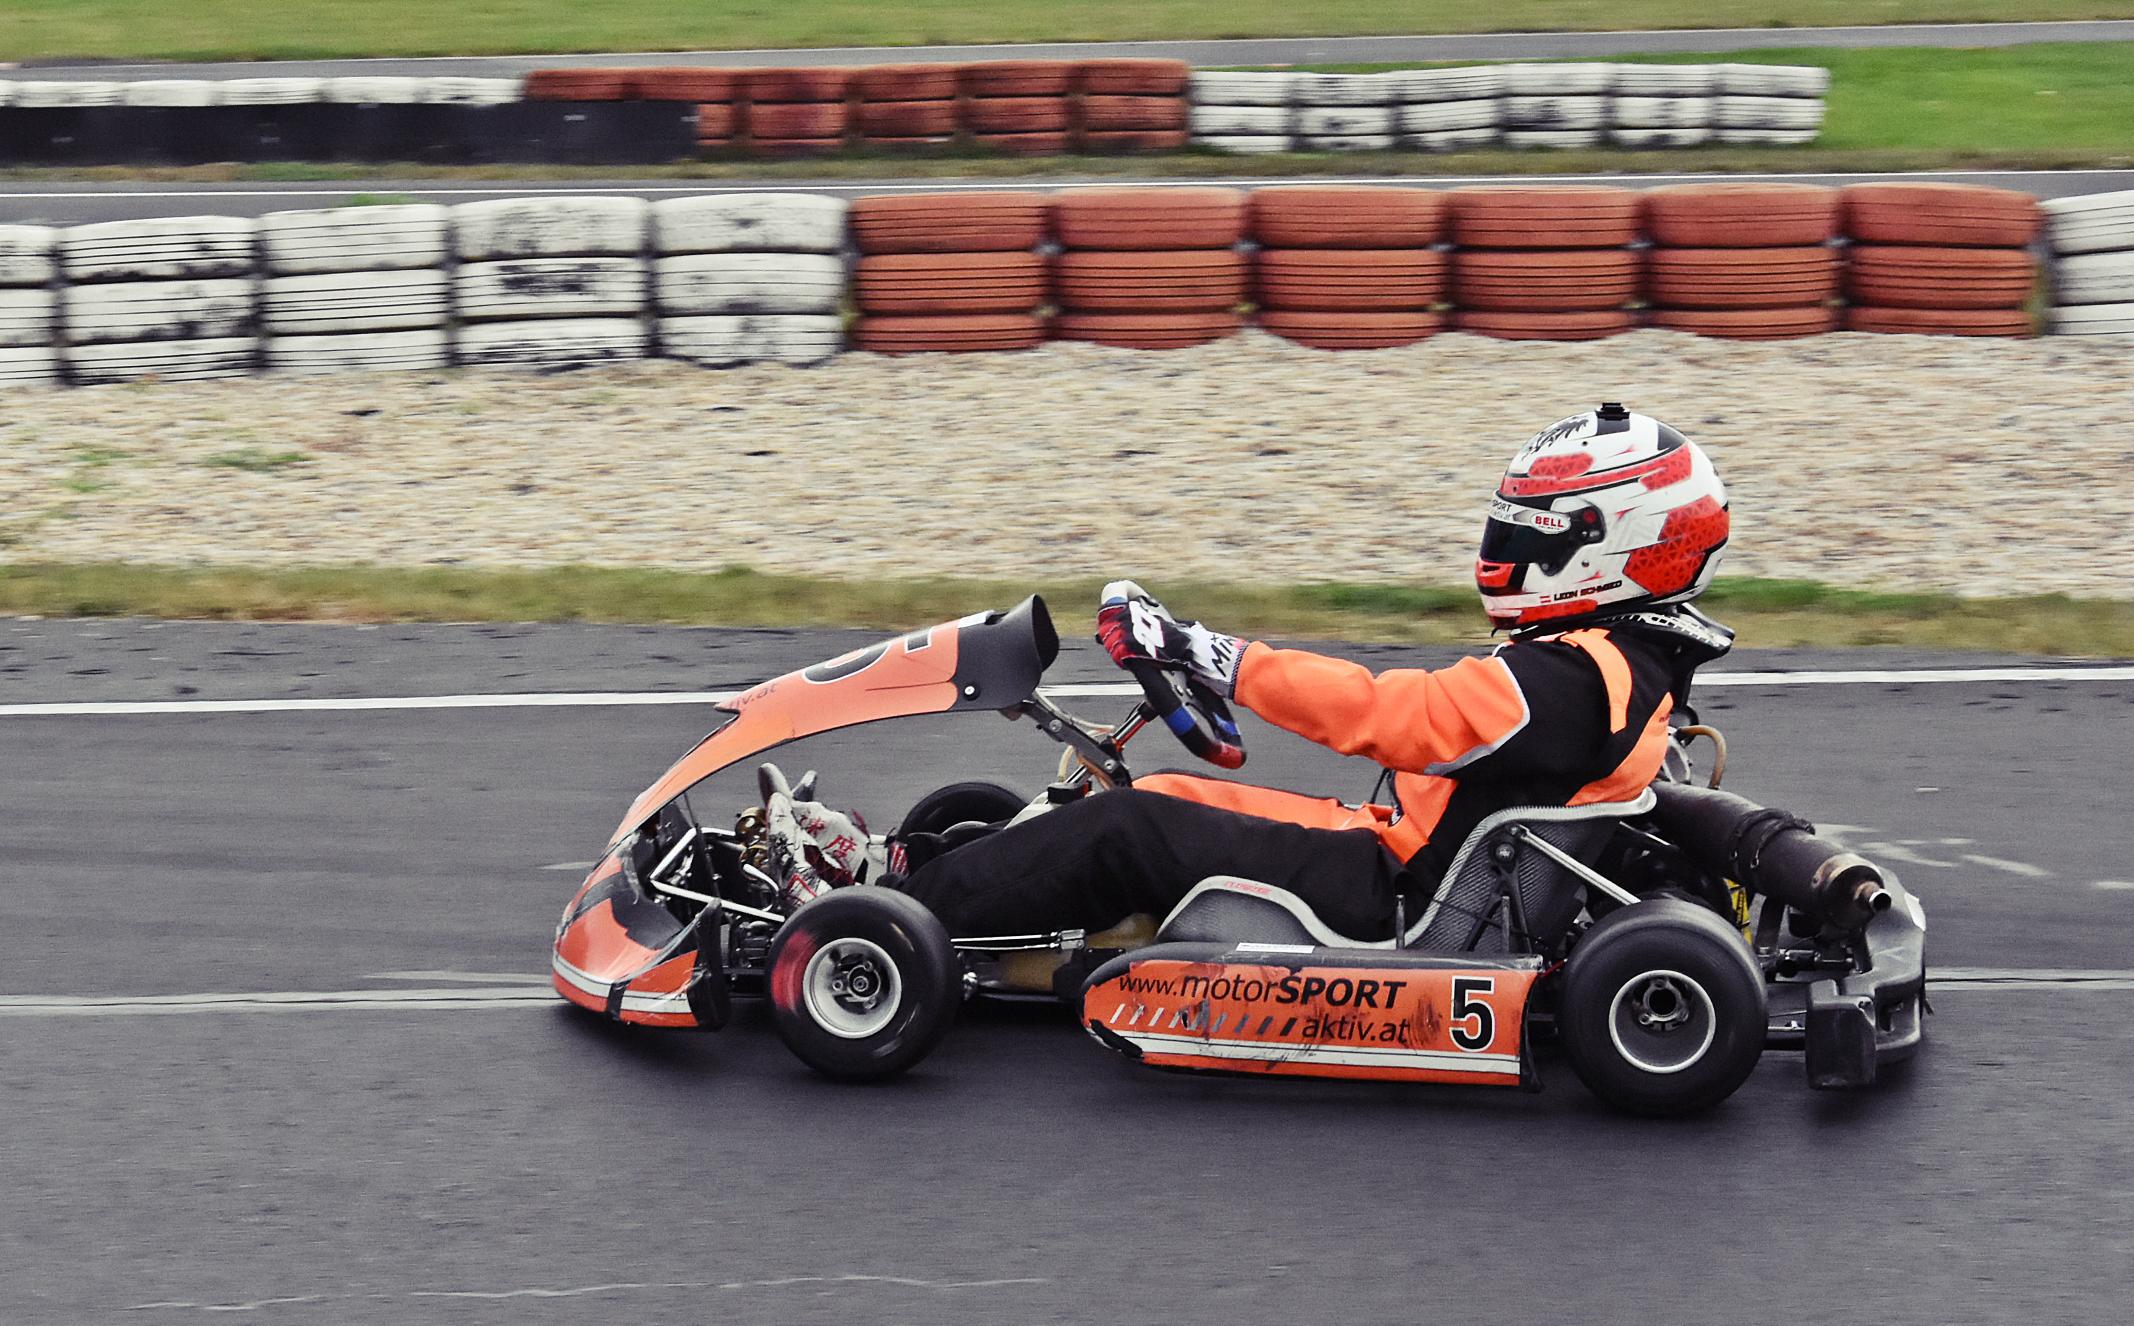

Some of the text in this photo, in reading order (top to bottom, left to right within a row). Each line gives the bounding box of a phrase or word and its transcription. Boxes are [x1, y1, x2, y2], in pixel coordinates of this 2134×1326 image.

[1535, 515, 1564, 528] BELL
[1553, 589, 1579, 601] LEON
[1118, 973, 1408, 1009] www.motorSPORT
[1301, 1013, 1411, 1044] aktiv.at
[1449, 975, 1495, 1053] 5
